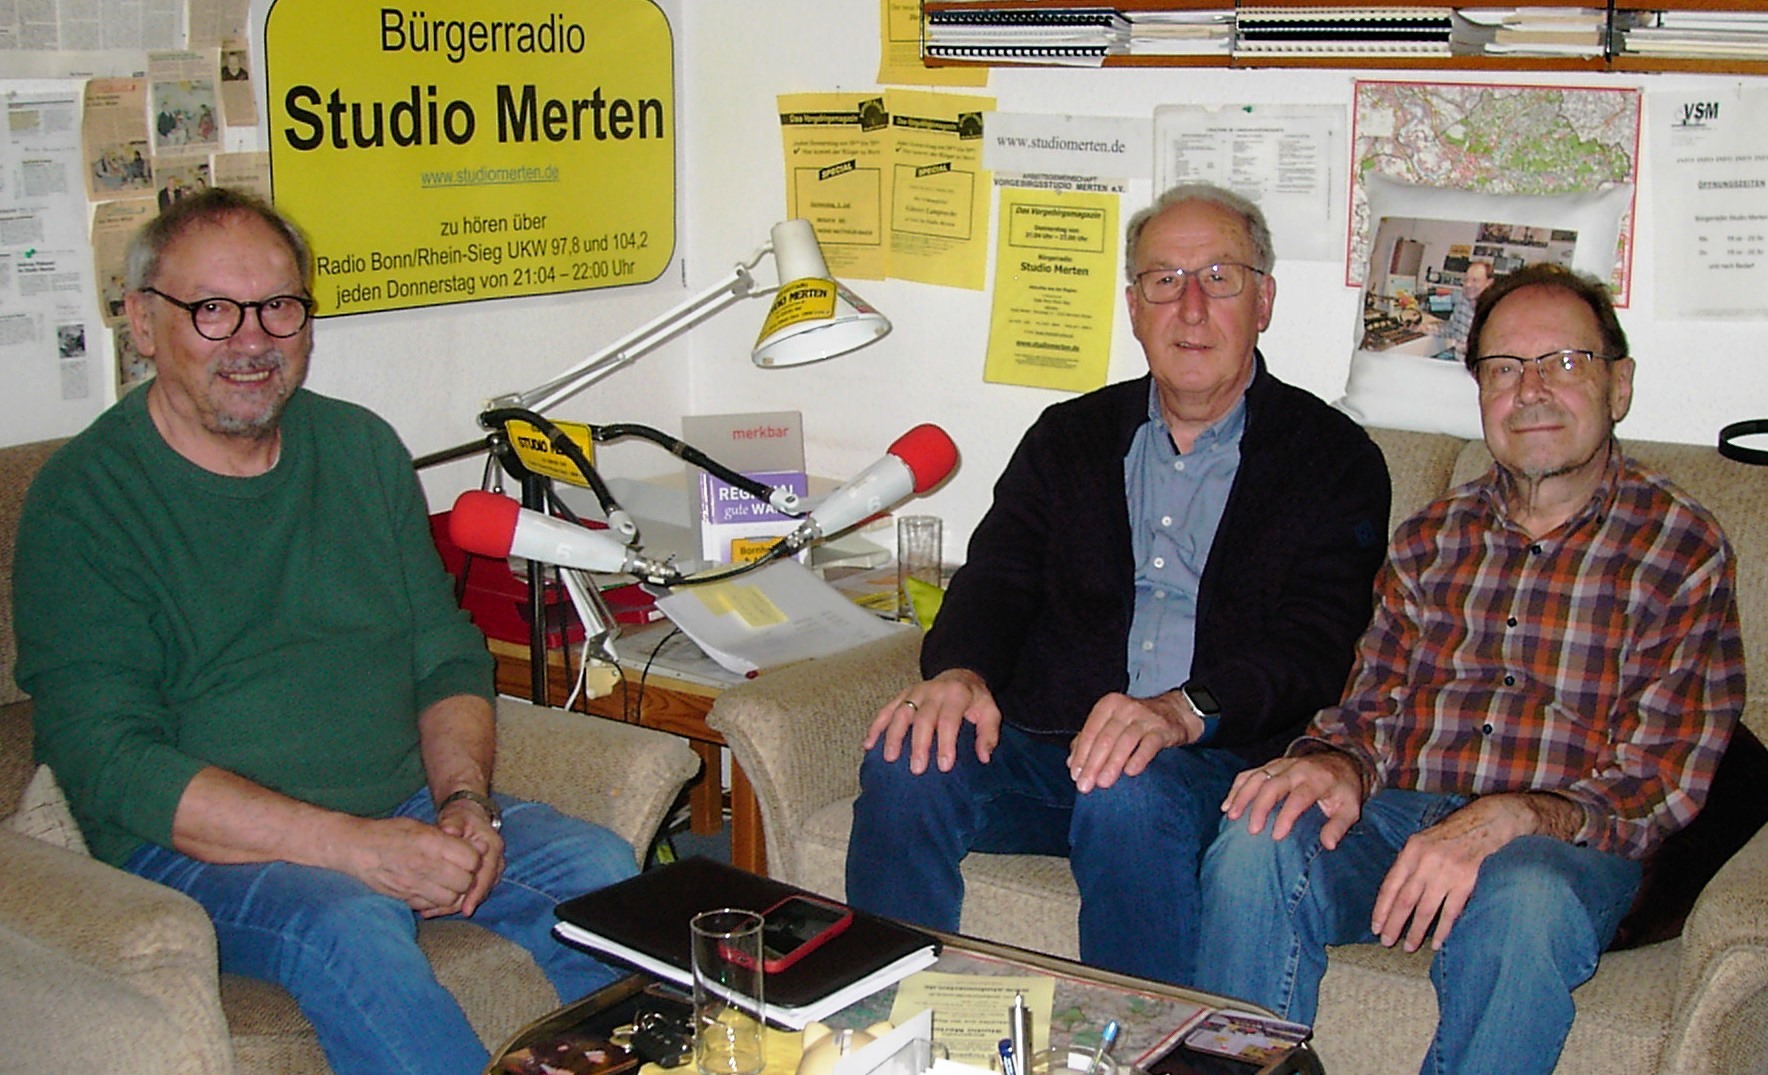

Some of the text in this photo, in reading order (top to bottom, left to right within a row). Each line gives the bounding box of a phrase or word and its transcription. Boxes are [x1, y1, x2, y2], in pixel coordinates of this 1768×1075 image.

[381, 8, 585, 63] Bürgerradio
[284, 84, 664, 151] Studio Merten
[1684, 102, 1719, 119] VSM
[997, 136, 1125, 153] www.studiomerten.de
[421, 166, 560, 188] www.studiomerten.de
[821, 162, 853, 180] SPECIAL
[919, 163, 947, 176] SPECIAL
[994, 179, 1072, 190] VORGEBIRGSSTUDIO
[1076, 184, 1108, 192] MERTEN
[1031, 208, 1101, 219] Vorgebirgsmagazin
[441, 213, 547, 236] zu hören über
[1034, 225, 1067, 233] Donnerstag
[317, 230, 648, 276] Radio Bonn/Rhein-Sieg UKW 97,8 und 104,2
[1020, 262, 1089, 275] Studio Merten
[335, 283, 381, 309] jeden
[387, 274, 475, 299] Donnerstag
[480, 273, 508, 289] von
[513, 266, 556, 286] 21:04
[572, 262, 609, 281] 22:00
[612, 259, 635, 276] Uhr
[789, 289, 827, 301] MERTEN
[732, 426, 790, 440] merkbar
[517, 436, 548, 453] STUDIO
[724, 505, 748, 520] gute
